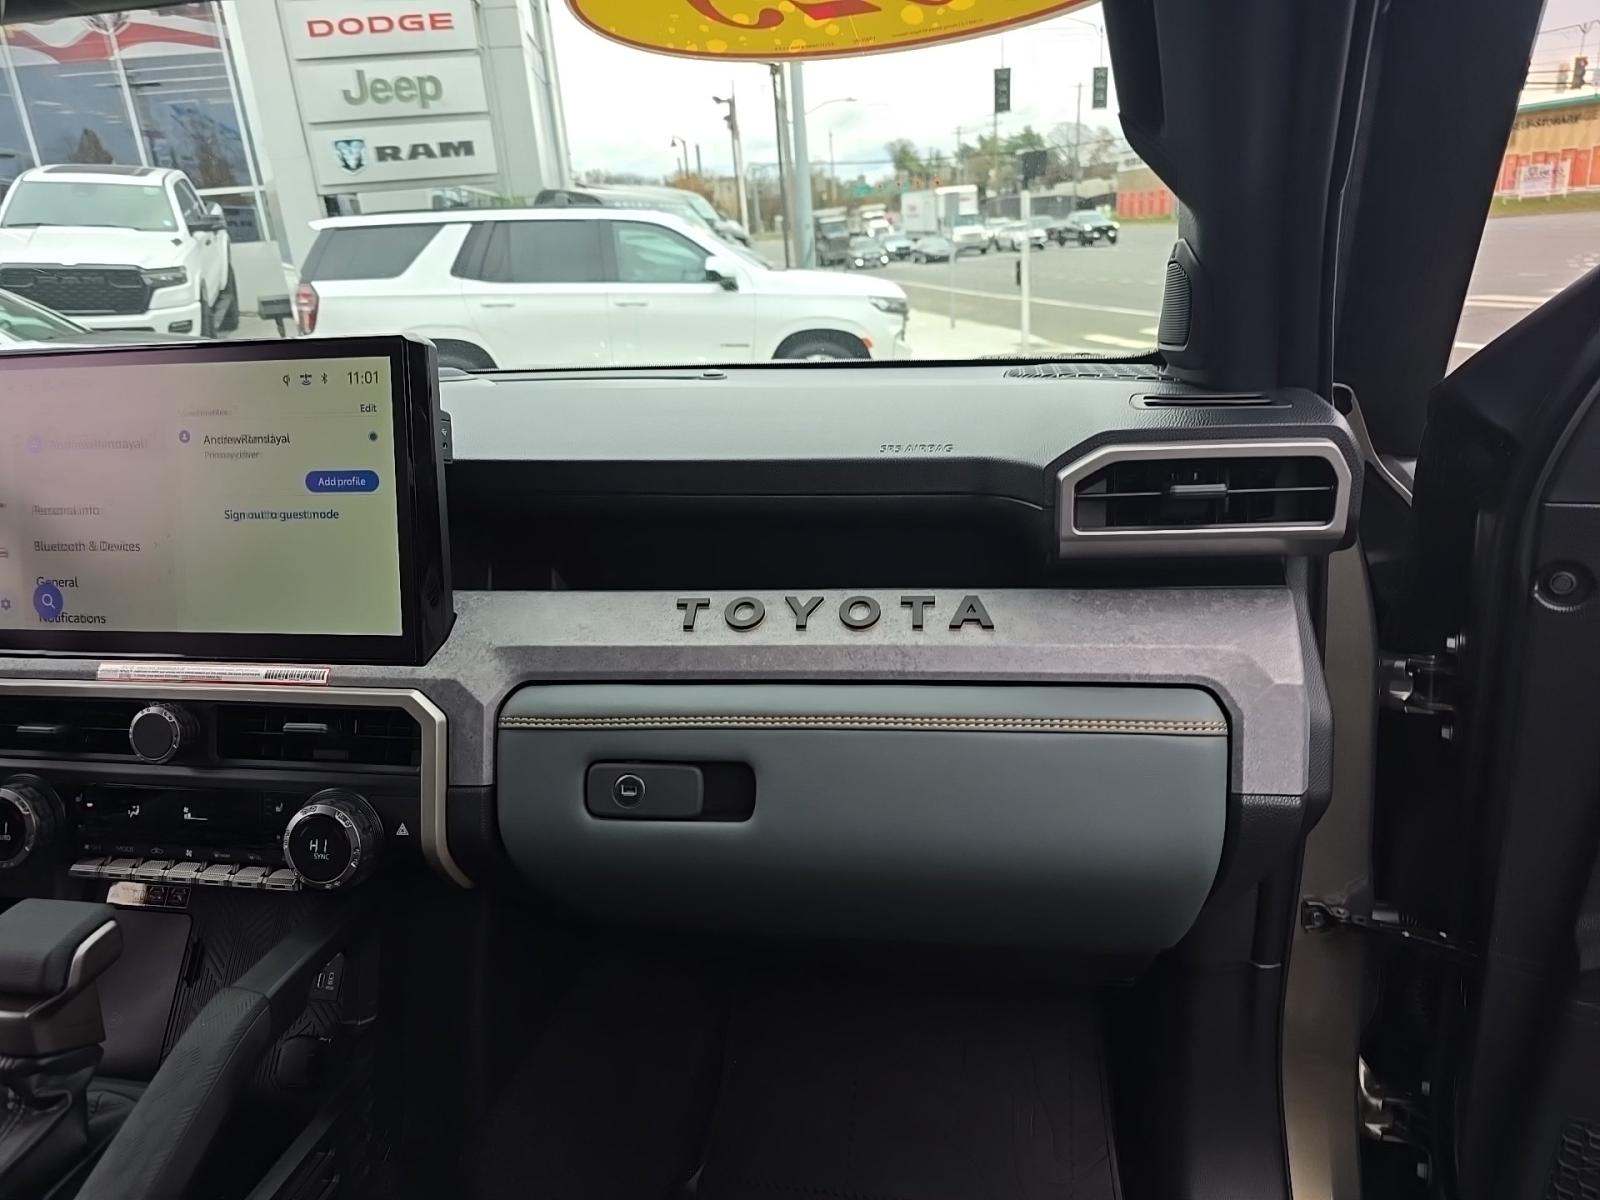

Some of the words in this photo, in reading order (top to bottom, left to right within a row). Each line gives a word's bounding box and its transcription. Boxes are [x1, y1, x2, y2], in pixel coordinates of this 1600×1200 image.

[307, 12, 454, 38] DODGE
[342, 69, 443, 109] Jeep
[374, 140, 476, 163] RAM
[347, 371, 379, 385] 11:01
[360, 403, 377, 413] Edit
[318, 475, 336, 486] Add
[337, 475, 366, 488] profile
[224, 509, 246, 522] Sign
[34, 540, 86, 551] Bluetooth
[676, 594, 995, 631] TOYOTA
